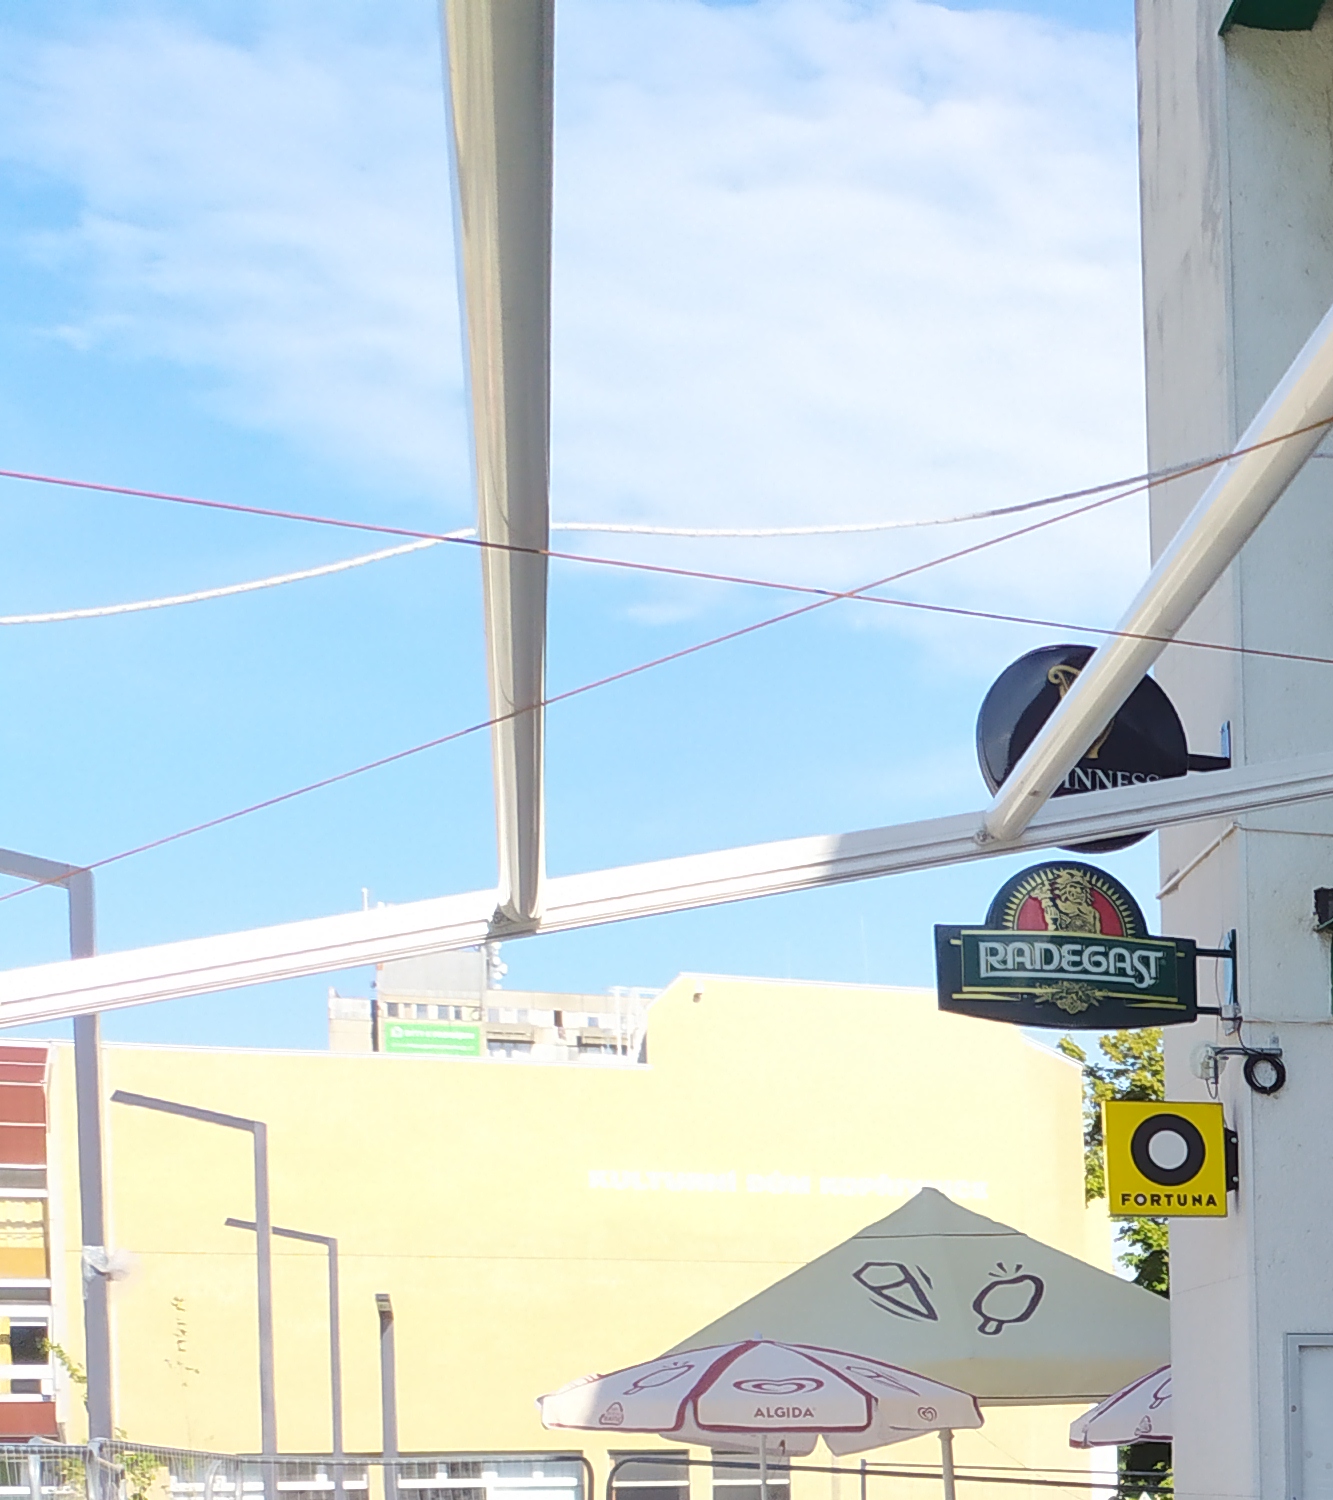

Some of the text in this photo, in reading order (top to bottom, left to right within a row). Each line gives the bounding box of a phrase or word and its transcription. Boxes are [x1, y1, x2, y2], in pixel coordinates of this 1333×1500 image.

[1063, 767, 1160, 791] INNES
[978, 940, 1164, 989] RADEGAST
[1121, 1193, 1218, 1207] FORTUNA
[754, 1407, 814, 1418] ALGIDA
